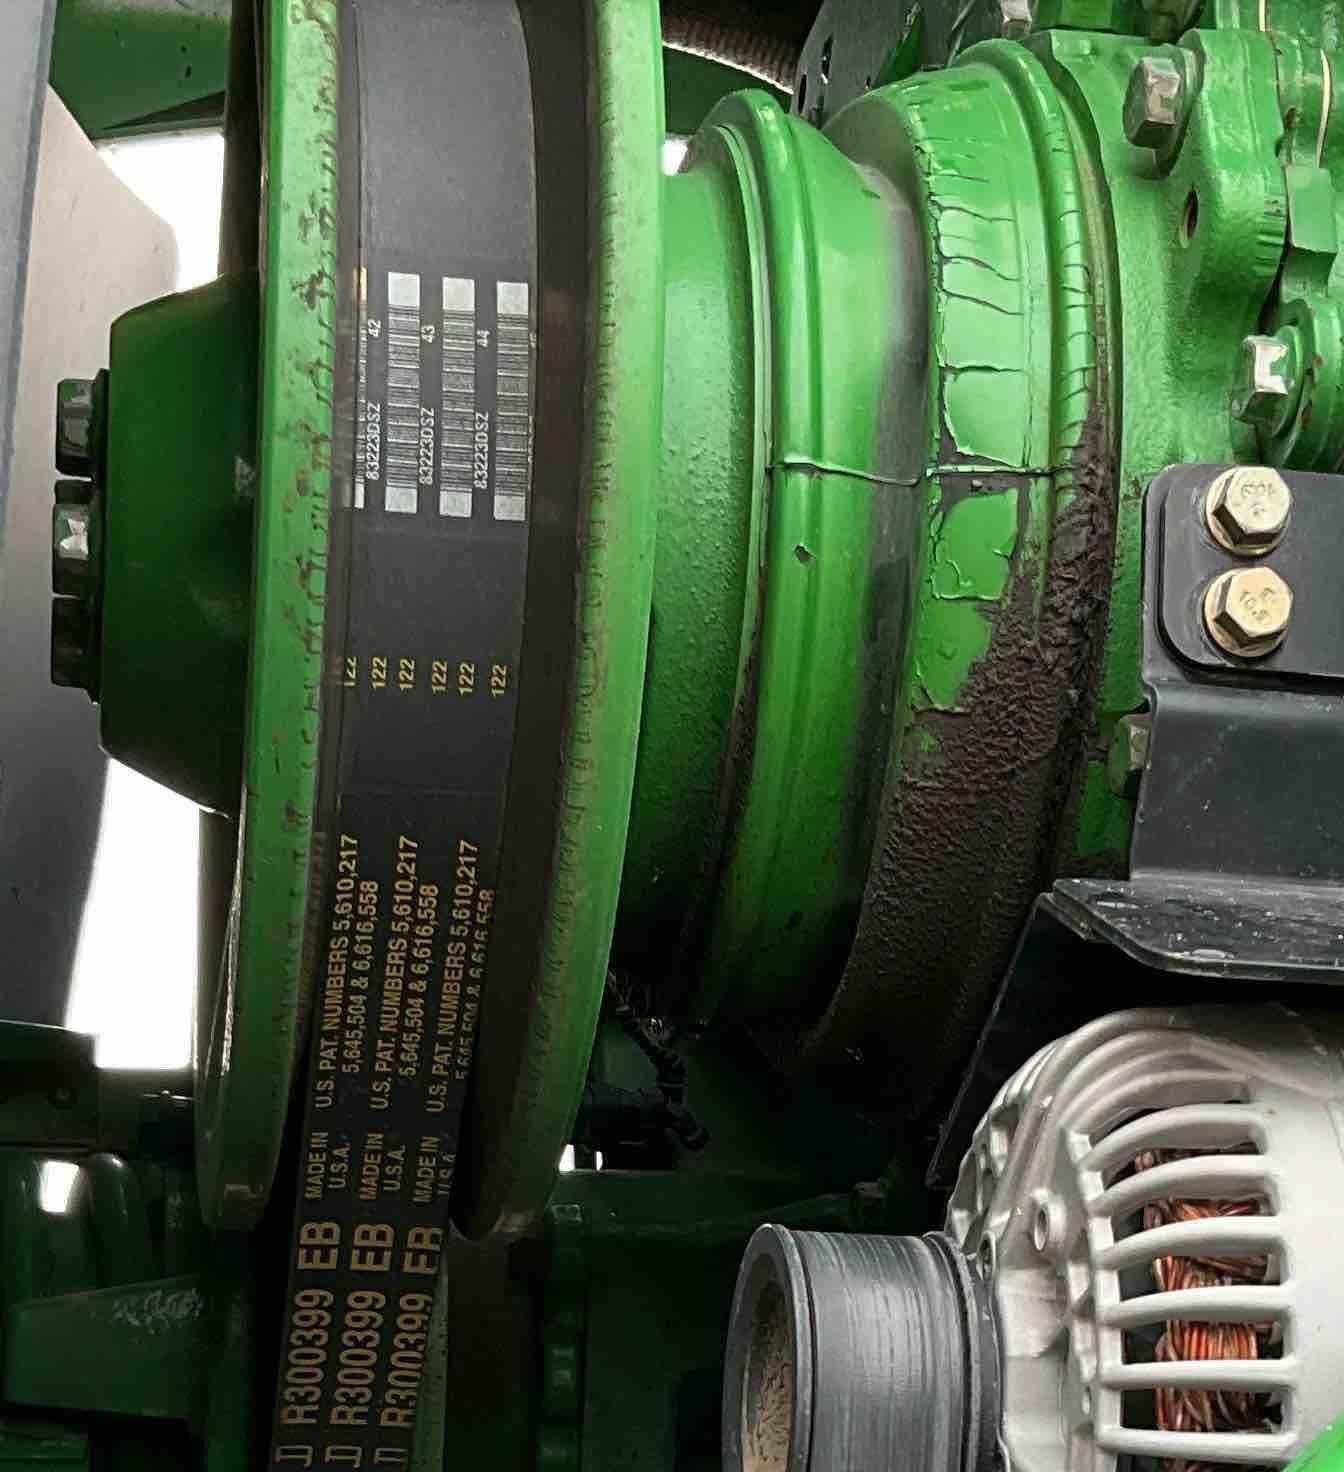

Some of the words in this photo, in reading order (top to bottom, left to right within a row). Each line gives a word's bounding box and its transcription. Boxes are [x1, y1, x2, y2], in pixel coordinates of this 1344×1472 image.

[368, 319, 382, 337] 42
[421, 325, 436, 343] 43
[476, 330, 490, 347] 44
[372, 656, 387, 690] 122
[399, 658, 415, 691] 122
[431, 661, 448, 694] 122
[458, 663, 475, 696] 122
[491, 664, 507, 698] 122
[333, 834, 358, 931] 5,610,217
[392, 836, 418, 933] 5,610,217
[450, 840, 478, 936] 5,610,217
[352, 880, 379, 971] 6,616,558
[410, 884, 439, 974] 6,616,558
[322, 936, 349, 1030] NUMBERS
[351, 977, 369, 990] &
[379, 938, 407, 1032] NUMBERS
[408, 980, 427, 992] &
[437, 942, 466, 1035] NUMBERS
[320, 1033, 338, 1070] PAT.
[342, 996, 367, 1073] 5,645,504
[375, 1037, 396, 1072] PAT.
[399, 999, 425, 1076] 5,645,504
[432, 1042, 453, 1075] PAT.
[315, 1076, 335, 1108] U.S.
[370, 1077, 392, 1109] U.S.
[425, 1081, 448, 1112] U.S.
[311, 1132, 328, 1148] IN
[366, 1133, 384, 1150] IN
[421, 1136, 440, 1152] IN
[305, 1152, 326, 1199] MADE
[328, 1143, 351, 1189] U.S.A.
[360, 1153, 381, 1200] MADE
[384, 1145, 405, 1191] U.S.A.
[413, 1157, 436, 1202] MADE
[297, 1222, 341, 1269] EB
[350, 1224, 394, 1271] EB
[280, 1289, 334, 1424] R300399
[329, 1290, 386, 1425] R300399
